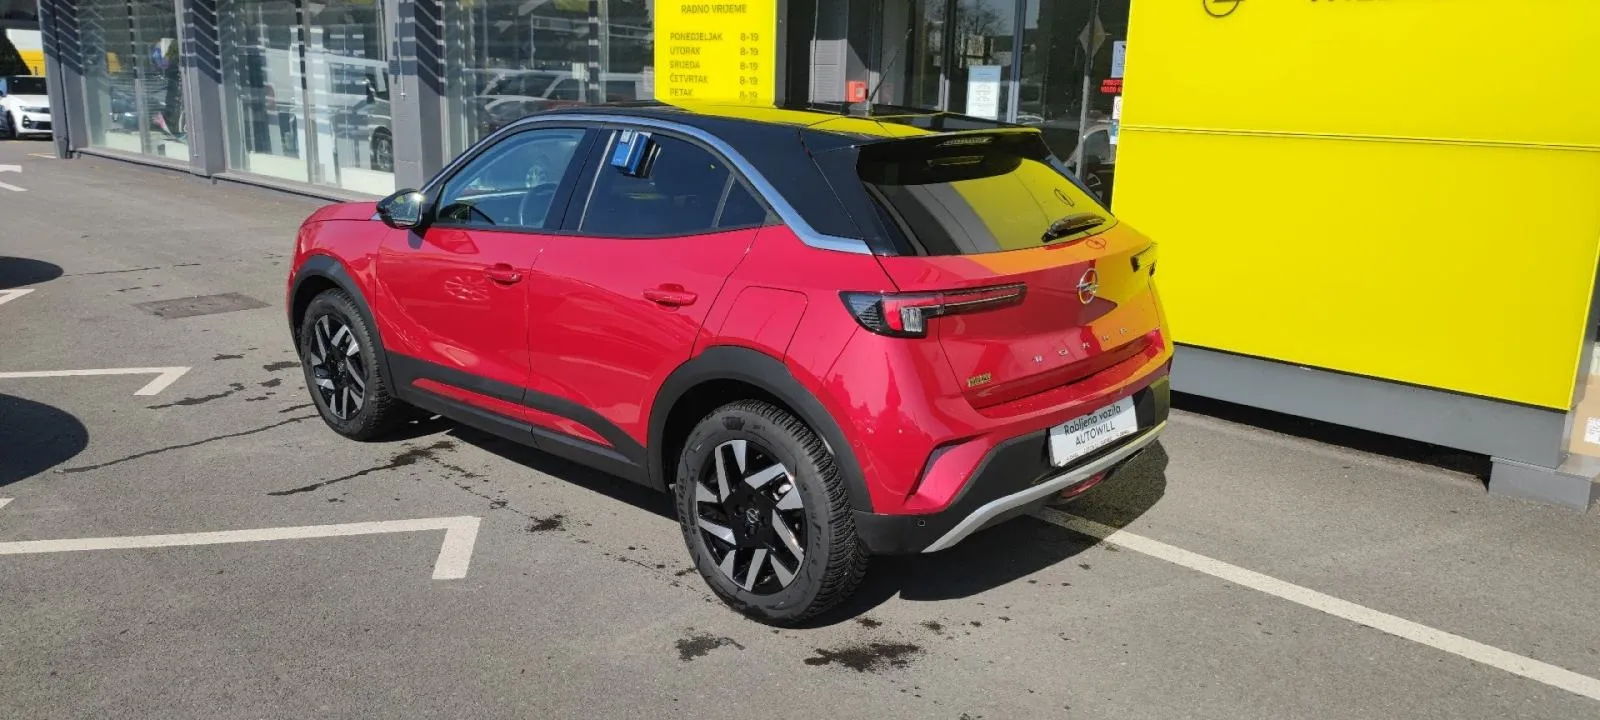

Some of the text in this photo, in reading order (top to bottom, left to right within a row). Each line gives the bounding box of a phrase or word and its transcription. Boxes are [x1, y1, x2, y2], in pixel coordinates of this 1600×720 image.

[681, 4, 747, 14] RADNO VRIJEME
[670, 32, 723, 41] PONEDJELJAK
[670, 46, 701, 55] UTORAK
[670, 60, 701, 69] SRIJEDA
[670, 73, 708, 83] ČETVRTAK
[670, 88, 694, 97] PETAK
[1075, 421, 1116, 446] AUTOWILL
